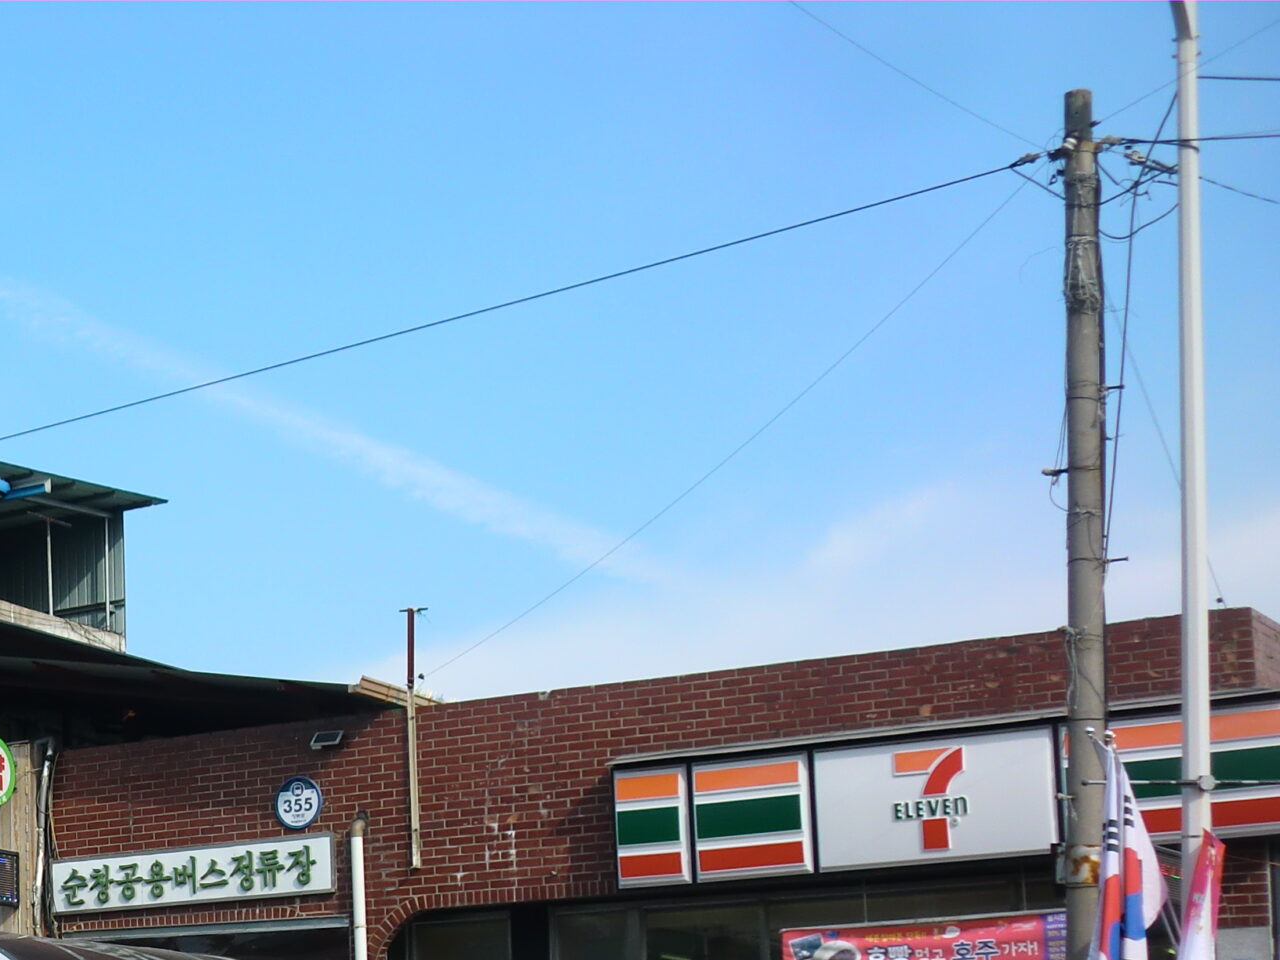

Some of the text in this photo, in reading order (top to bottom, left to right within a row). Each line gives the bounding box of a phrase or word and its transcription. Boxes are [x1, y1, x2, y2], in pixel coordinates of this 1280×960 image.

[282, 798, 313, 814] 355
[892, 745, 965, 851] 7
[60, 845, 317, 905] 순창공용버스정류장
[1002, 941, 1039, 958] 가자!
